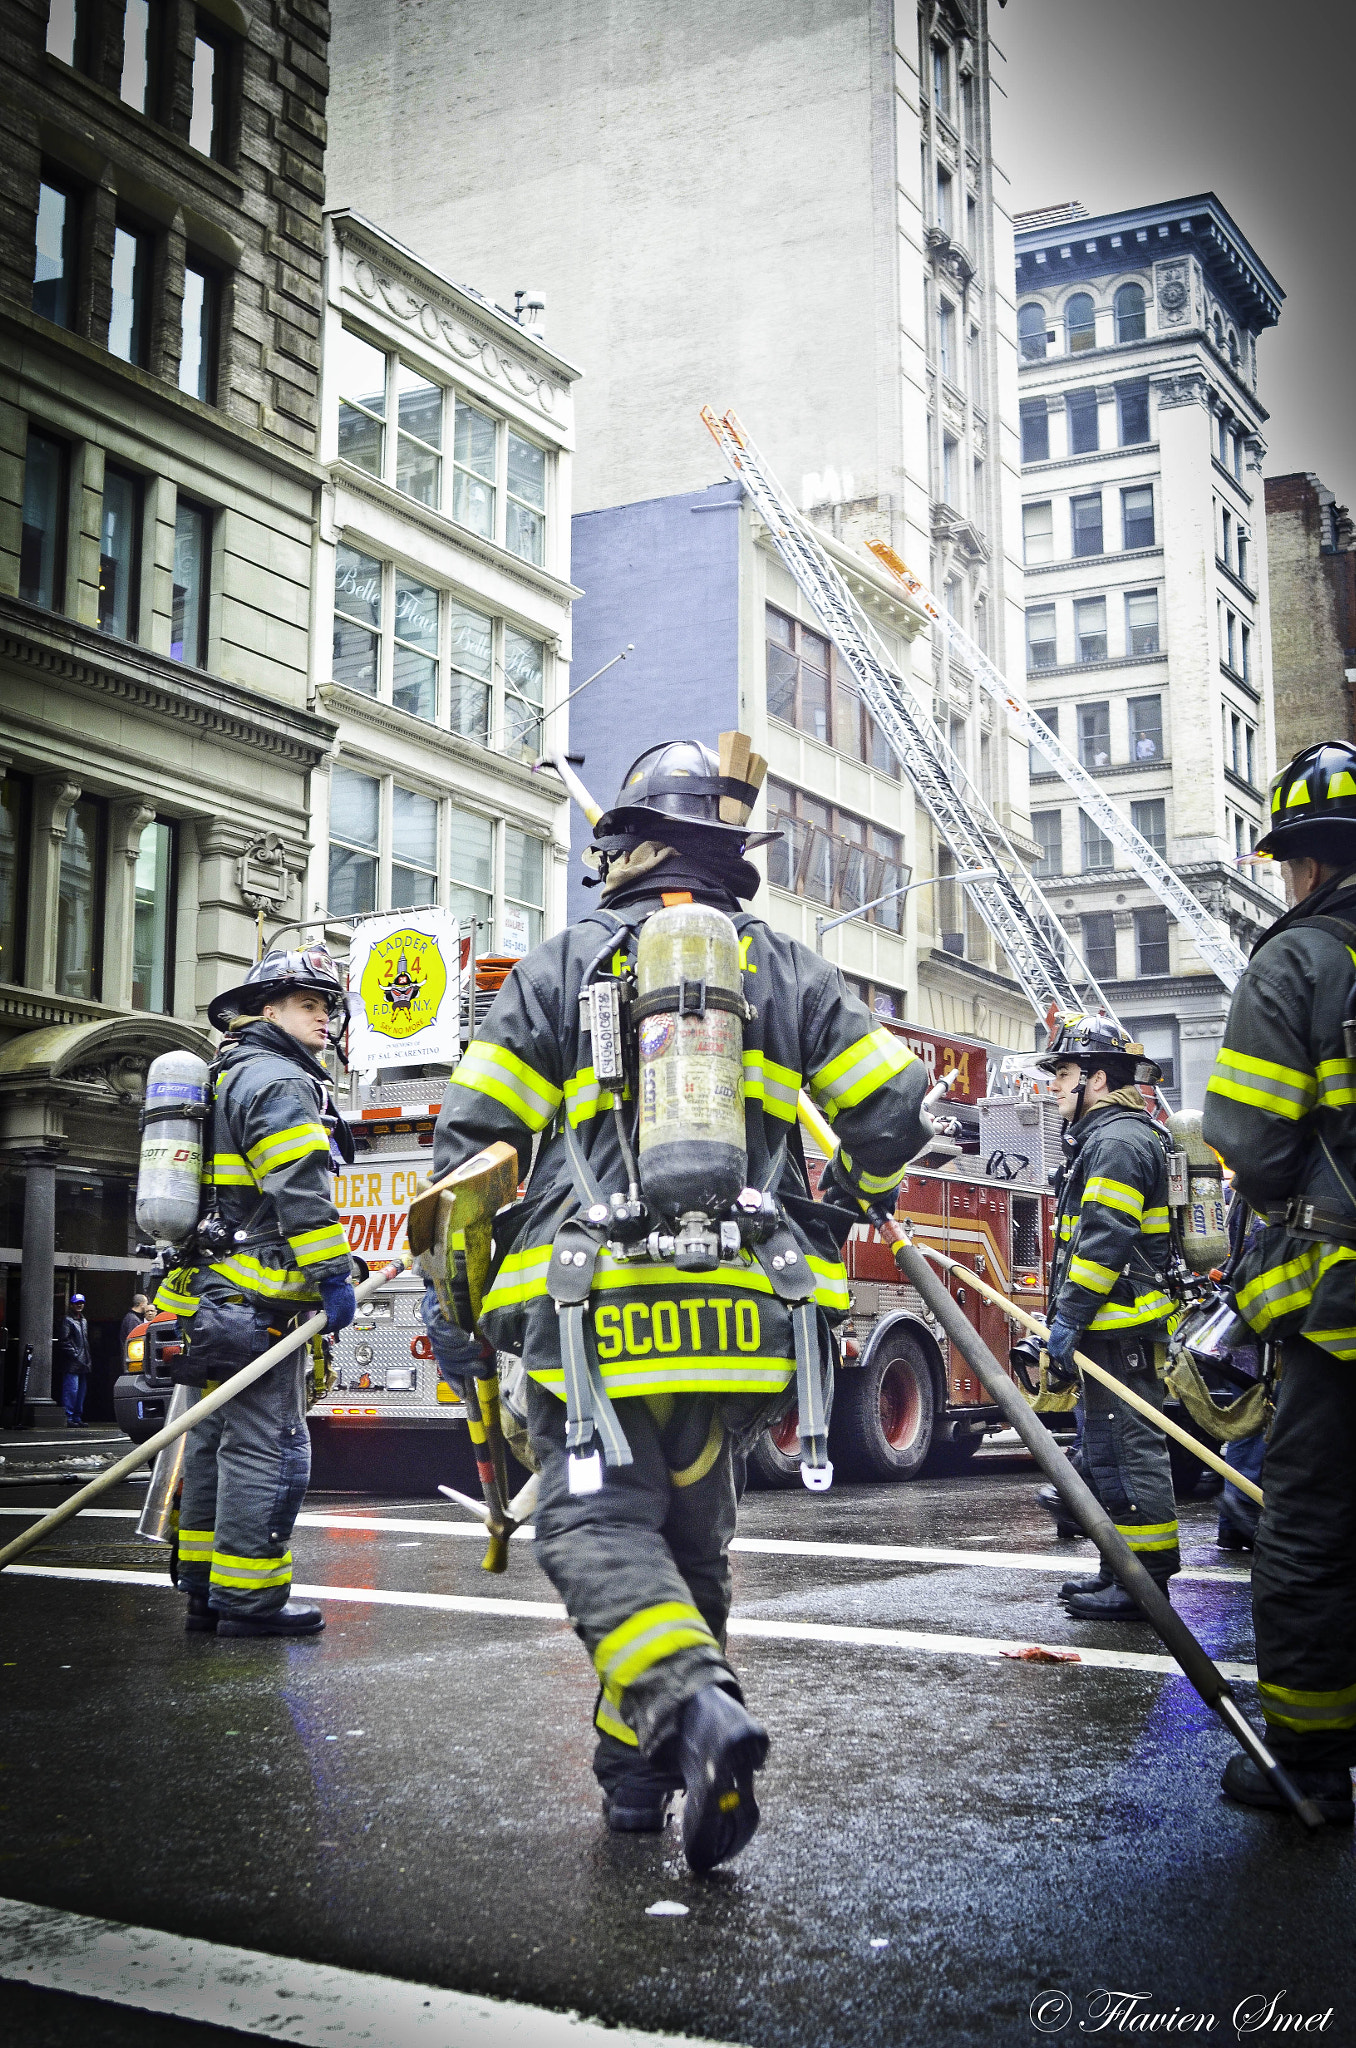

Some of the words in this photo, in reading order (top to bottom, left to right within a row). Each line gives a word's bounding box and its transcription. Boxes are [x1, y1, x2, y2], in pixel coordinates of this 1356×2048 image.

[335, 563, 380, 606] Belle
[395, 590, 437, 633] Fleur
[452, 620, 491, 657] Belle
[506, 645, 543, 683] Fleur
[378, 935, 428, 958] LADDER
[384, 960, 394, 978] 2
[411, 956, 422, 974] 4
[373, 1003, 391, 1015] F.D.
[413, 999, 432, 1011] N.Y.
[380, 1021, 392, 1033] SAY
[393, 1026, 404, 1035] NO
[405, 1018, 425, 1034] MORE
[943, 1047, 970, 1094] 24
[644, 1068, 656, 1123] SCOTT
[1193, 1203, 1207, 1236] SCOTT
[1215, 1202, 1225, 1233] SCOTT
[594, 1298, 761, 1359] SCOTTO
